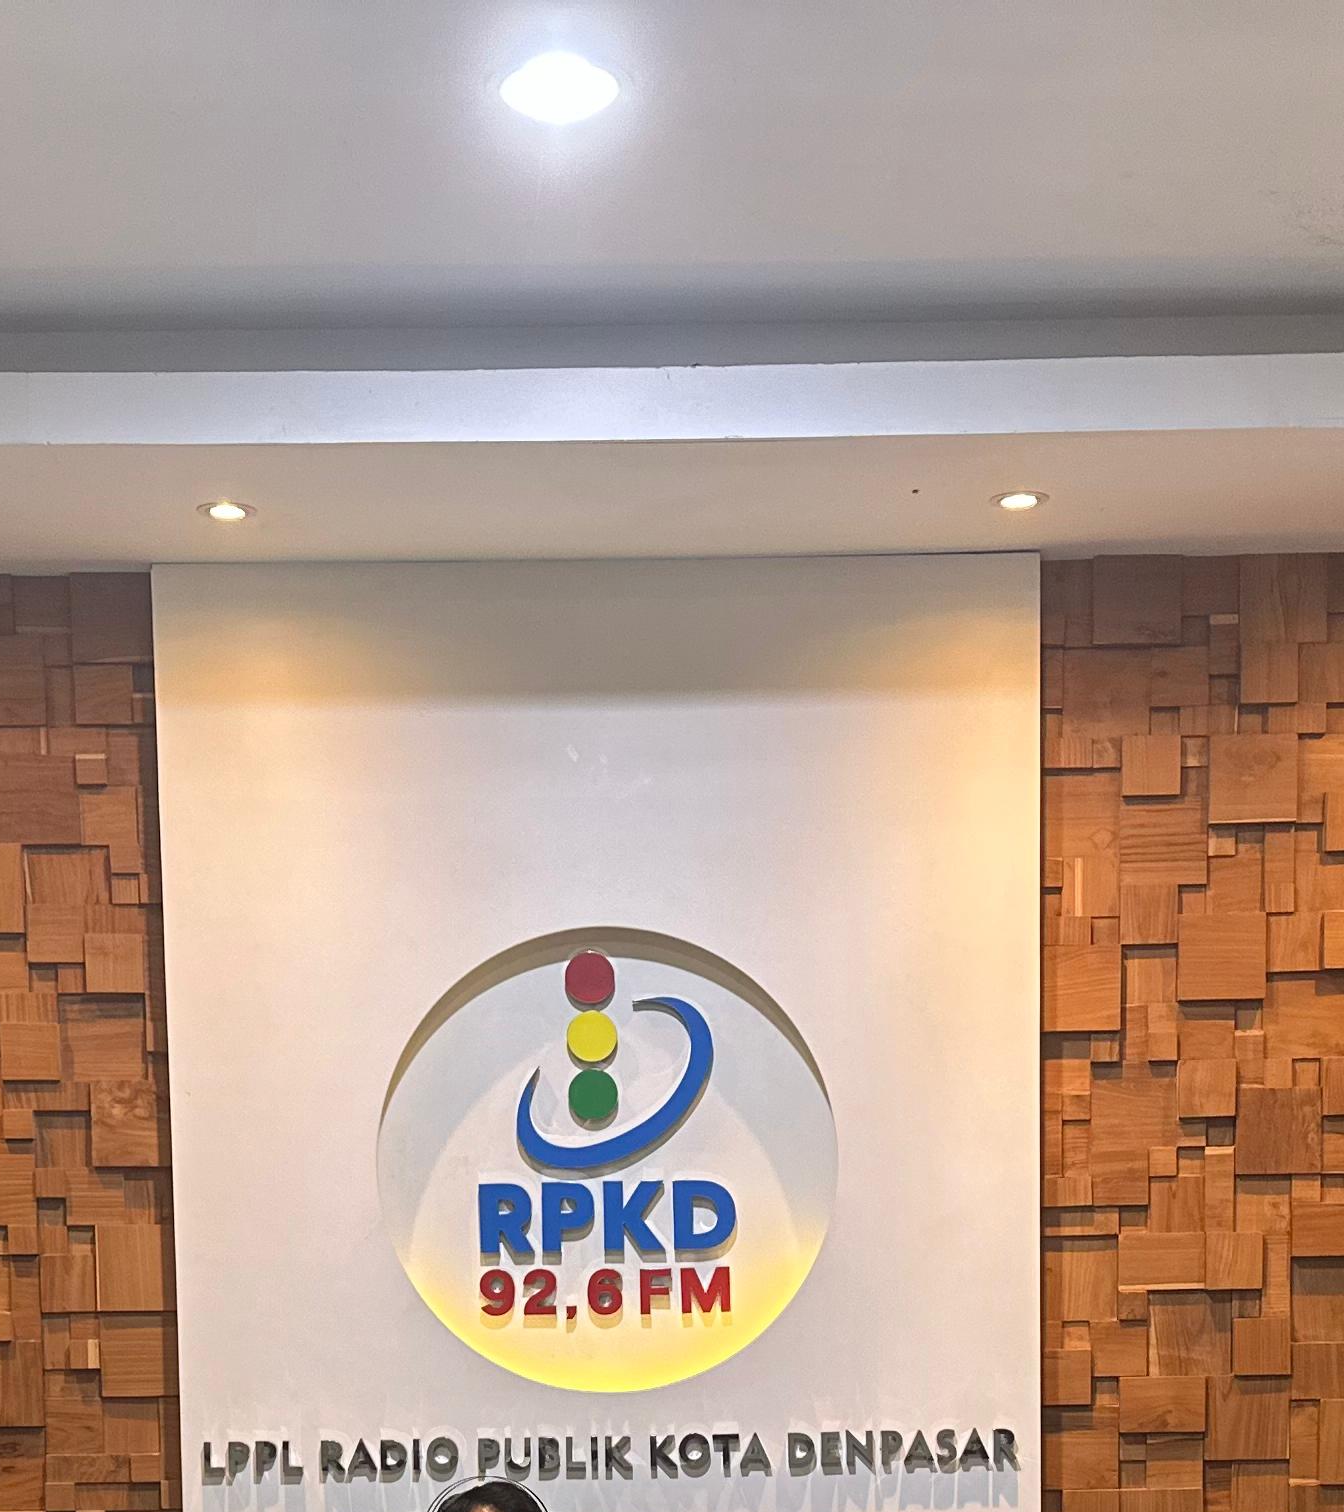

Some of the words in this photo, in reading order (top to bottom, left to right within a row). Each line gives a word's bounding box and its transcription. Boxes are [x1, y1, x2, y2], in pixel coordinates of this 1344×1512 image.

[478, 1179, 738, 1256] RPKD
[479, 1268, 623, 1320] 92,6
[639, 1266, 732, 1315] FM
[202, 1440, 304, 1481] LPPL
[320, 1437, 459, 1480] RADIO
[477, 1434, 634, 1479] PUBLIK
[650, 1432, 772, 1476] KOTA
[787, 1427, 1021, 1475] DENPASAR
